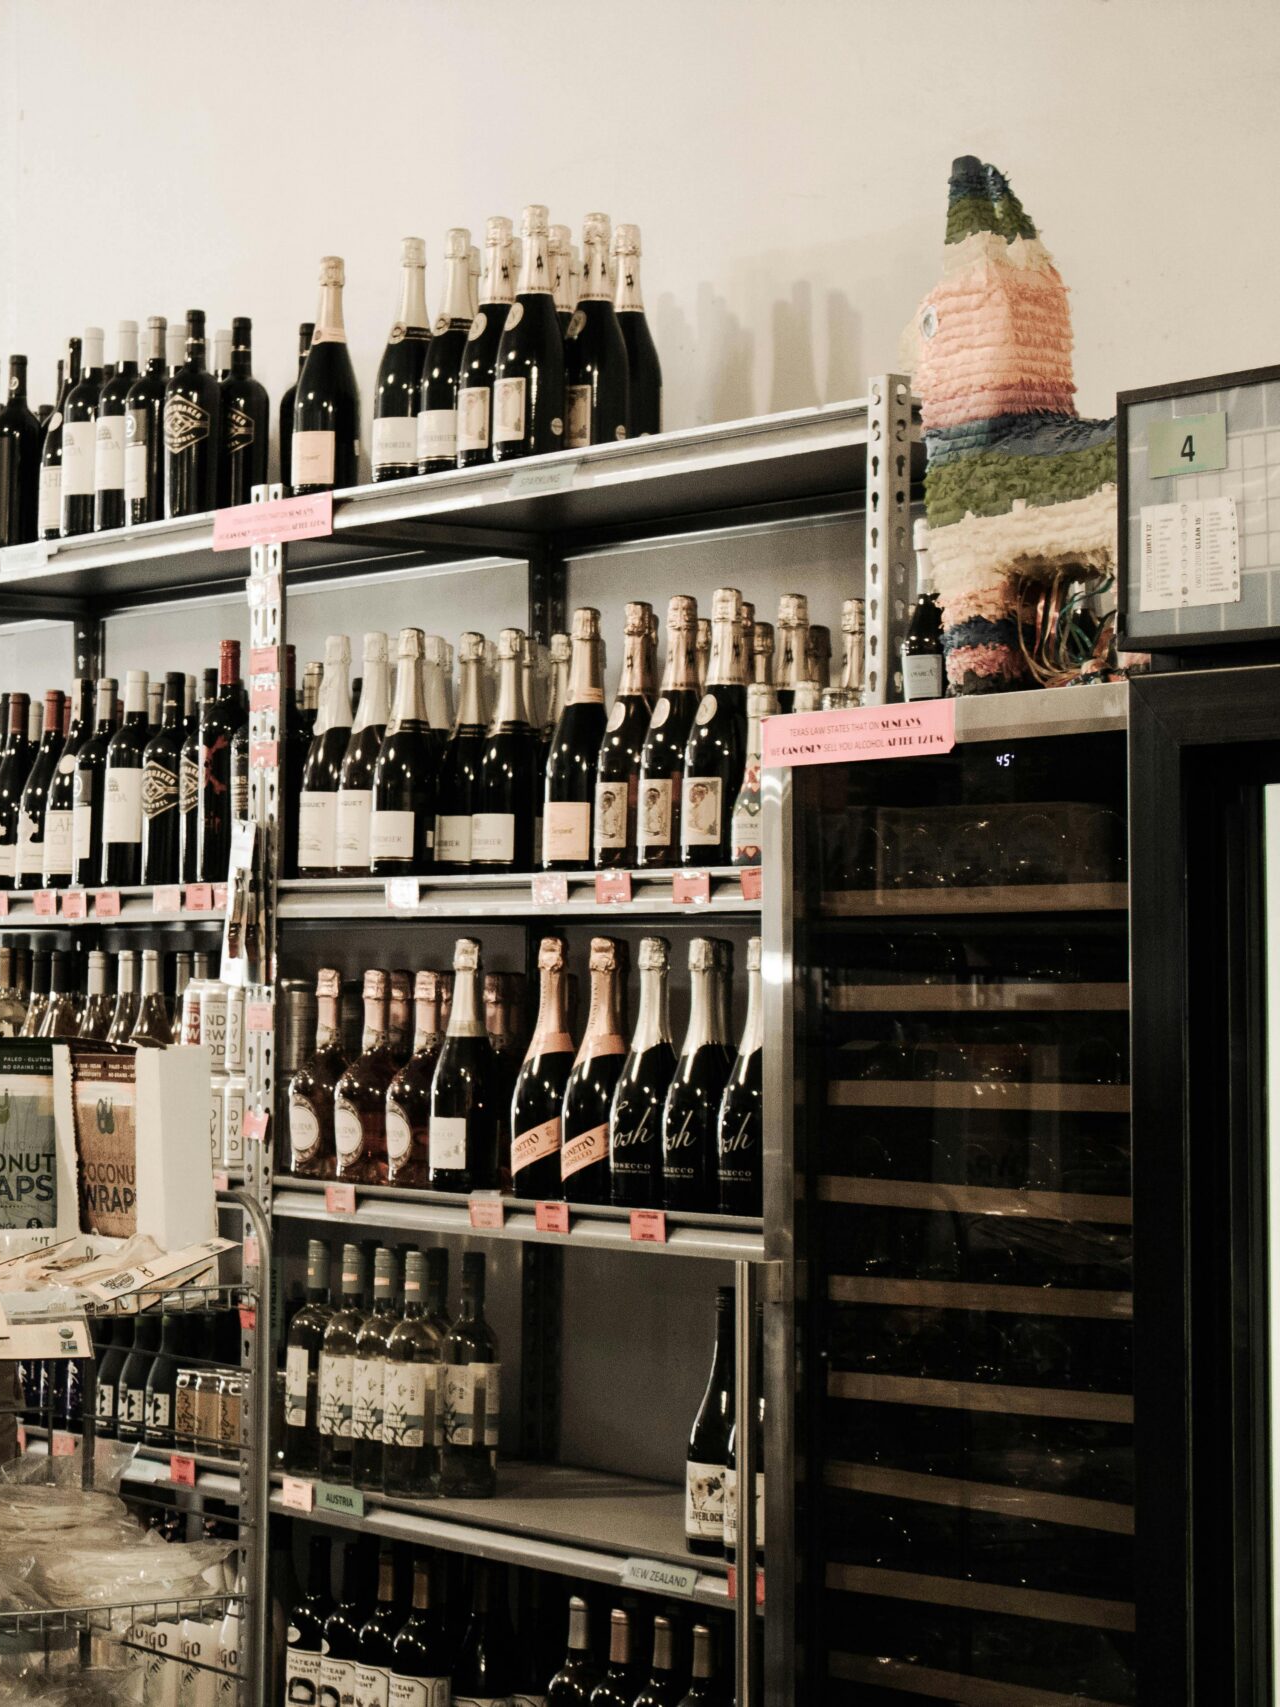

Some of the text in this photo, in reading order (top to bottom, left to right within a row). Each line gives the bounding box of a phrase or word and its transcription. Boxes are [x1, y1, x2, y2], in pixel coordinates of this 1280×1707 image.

[1180, 434, 1196, 462] 4
[83, 1184, 137, 1214] WRAP
[325, 1492, 354, 1508] AUSTRIA
[629, 1566, 688, 1588] NEW ZEALAND
